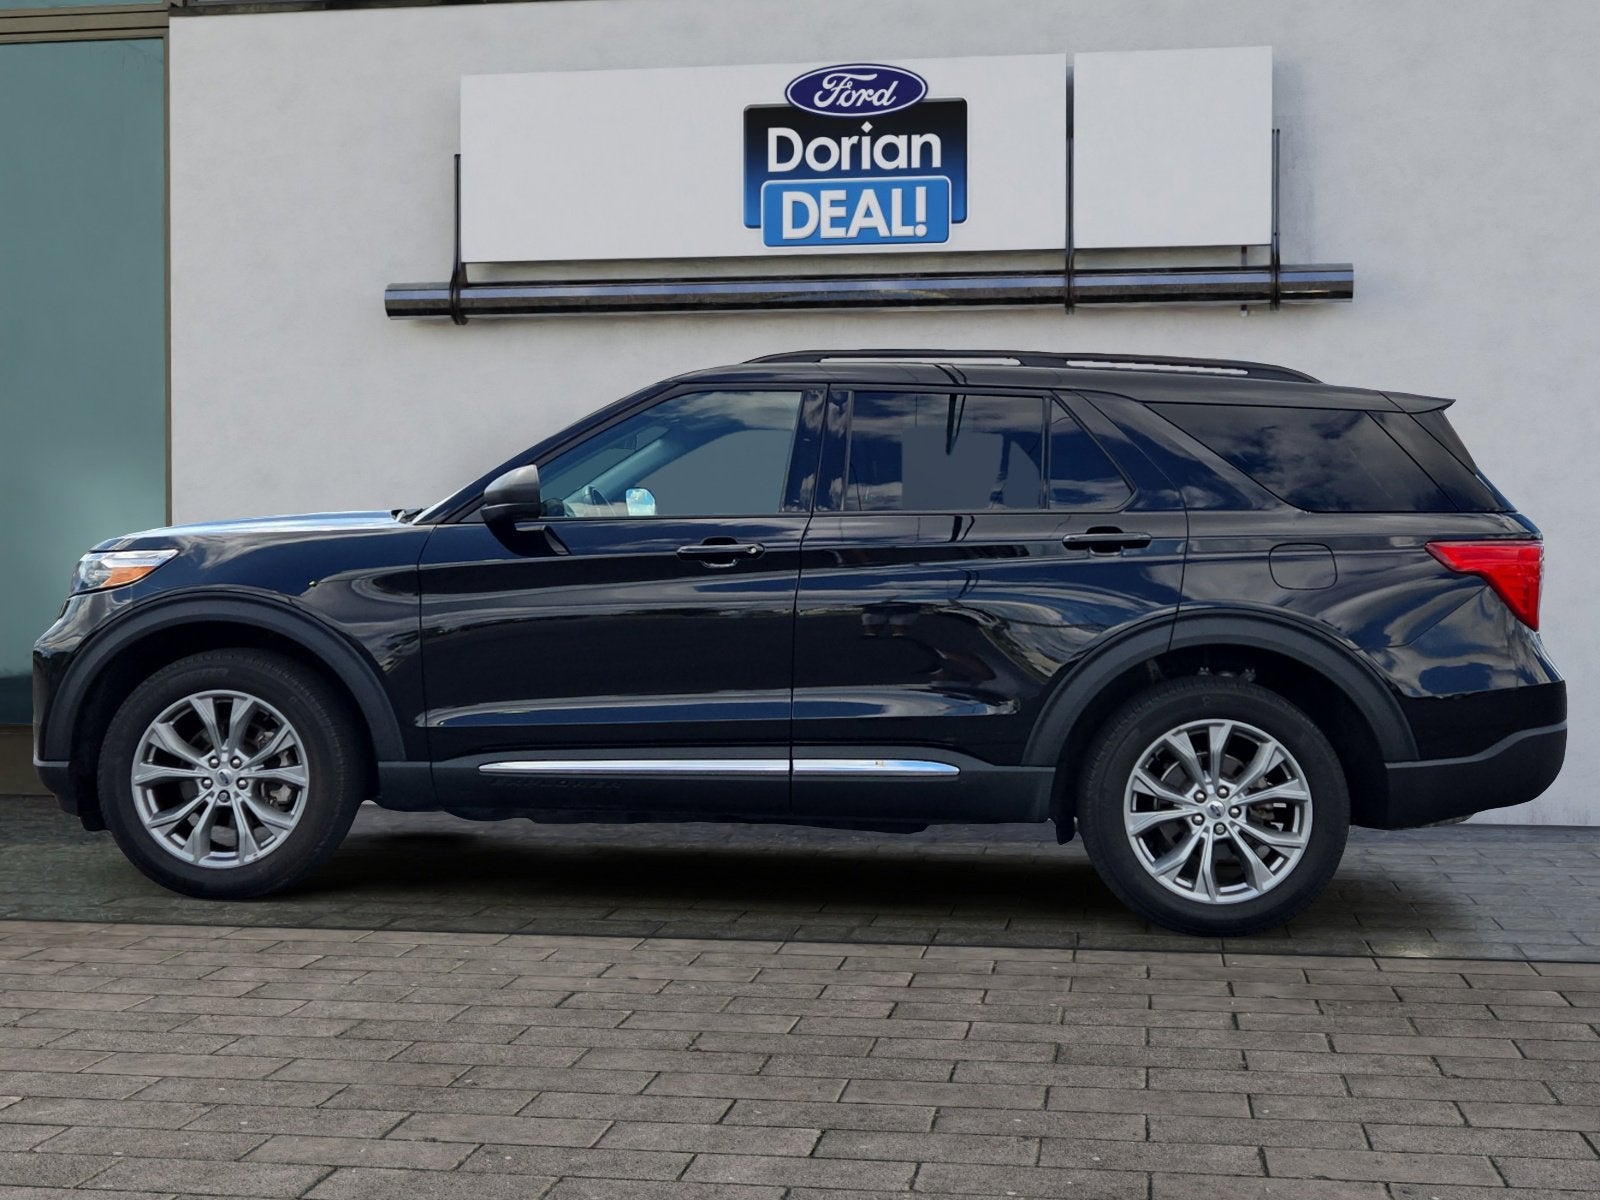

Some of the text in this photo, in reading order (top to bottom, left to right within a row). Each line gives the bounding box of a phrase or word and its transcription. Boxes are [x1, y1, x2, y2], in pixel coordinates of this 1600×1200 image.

[813, 72, 899, 107] Ford
[767, 121, 942, 172] Dorian
[782, 186, 928, 240] DEAL!
